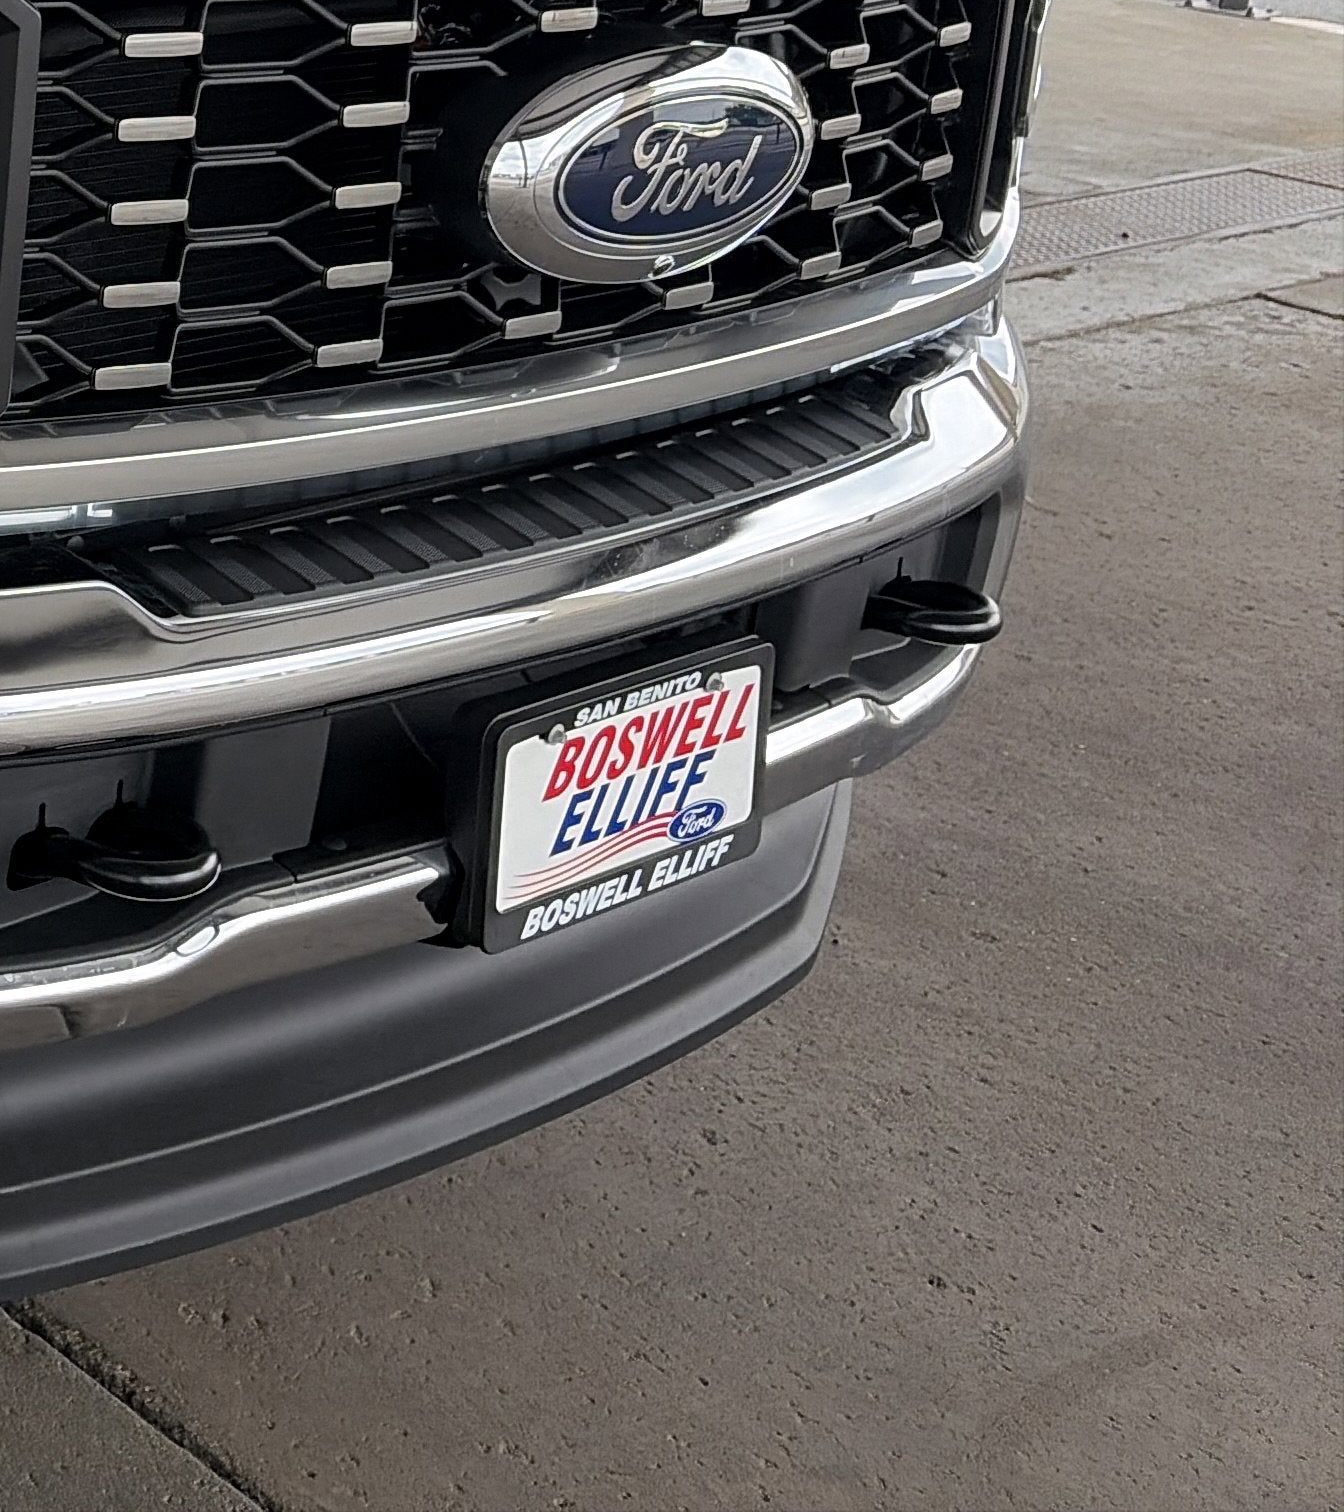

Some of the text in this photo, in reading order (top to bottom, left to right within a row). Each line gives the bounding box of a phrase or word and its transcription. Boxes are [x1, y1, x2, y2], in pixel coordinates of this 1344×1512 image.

[611, 117, 763, 223] Ford
[542, 683, 756, 801] BOSWELL
[574, 671, 702, 727] SAN BENITO
[549, 750, 717, 857] ELLIFF
[677, 804, 717, 838] Ford
[520, 834, 735, 940] BOSWELL ELLIFF
